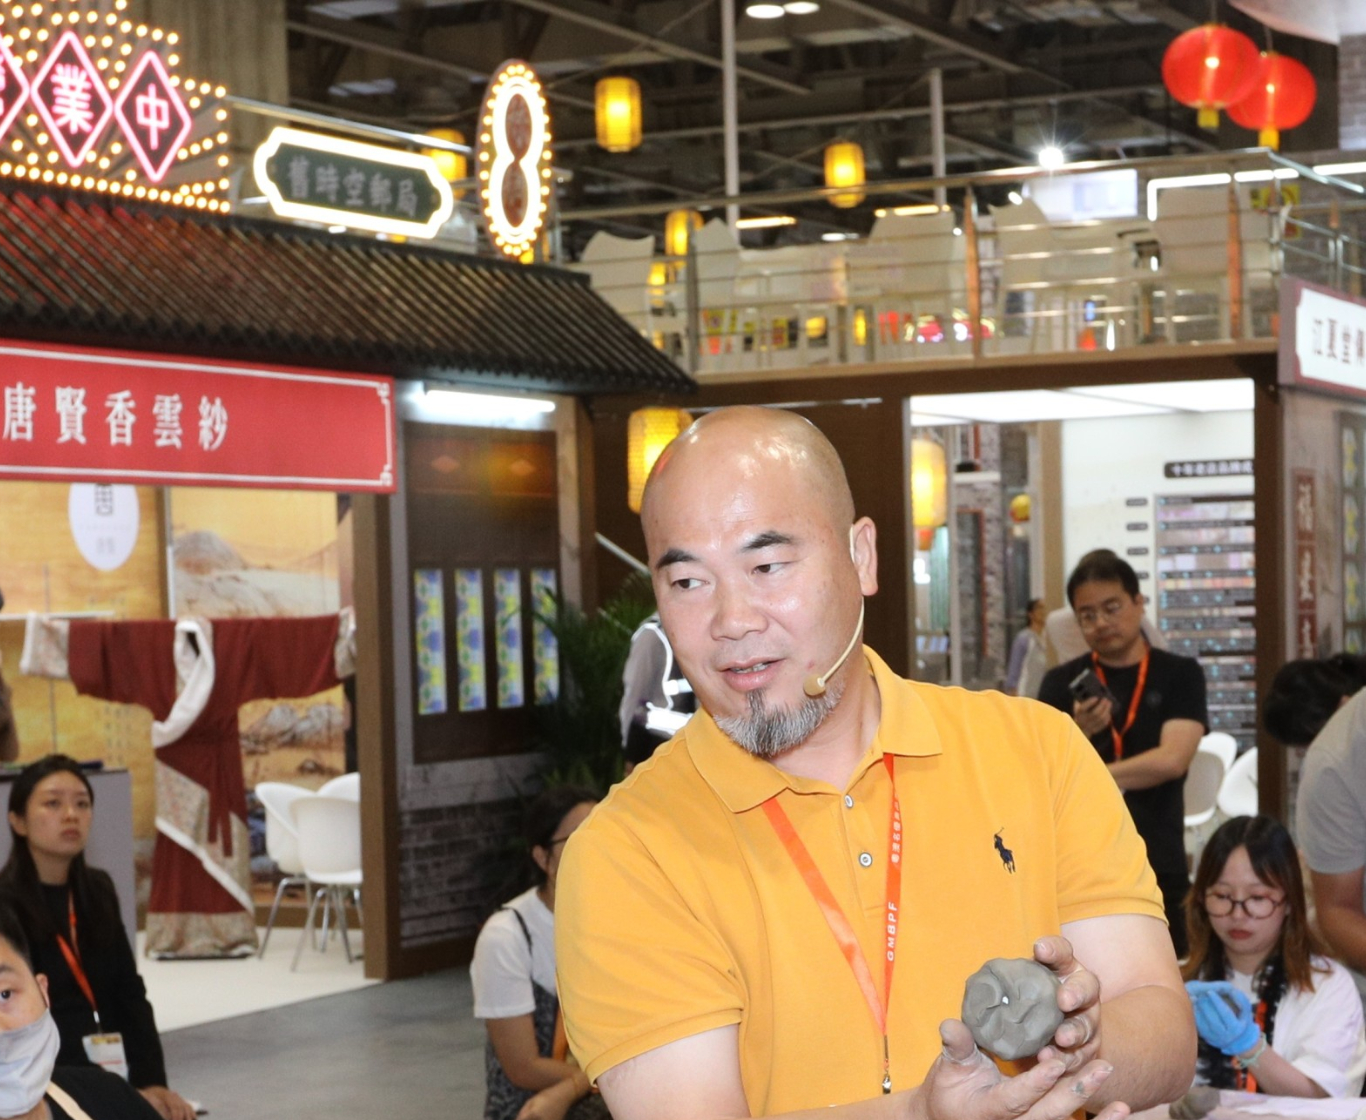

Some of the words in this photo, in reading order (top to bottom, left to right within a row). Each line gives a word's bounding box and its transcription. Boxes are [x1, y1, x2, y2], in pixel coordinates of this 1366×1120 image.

[3, 382, 228, 450] 唐賢香雲紗
[886, 901, 898, 962] GMBPF
